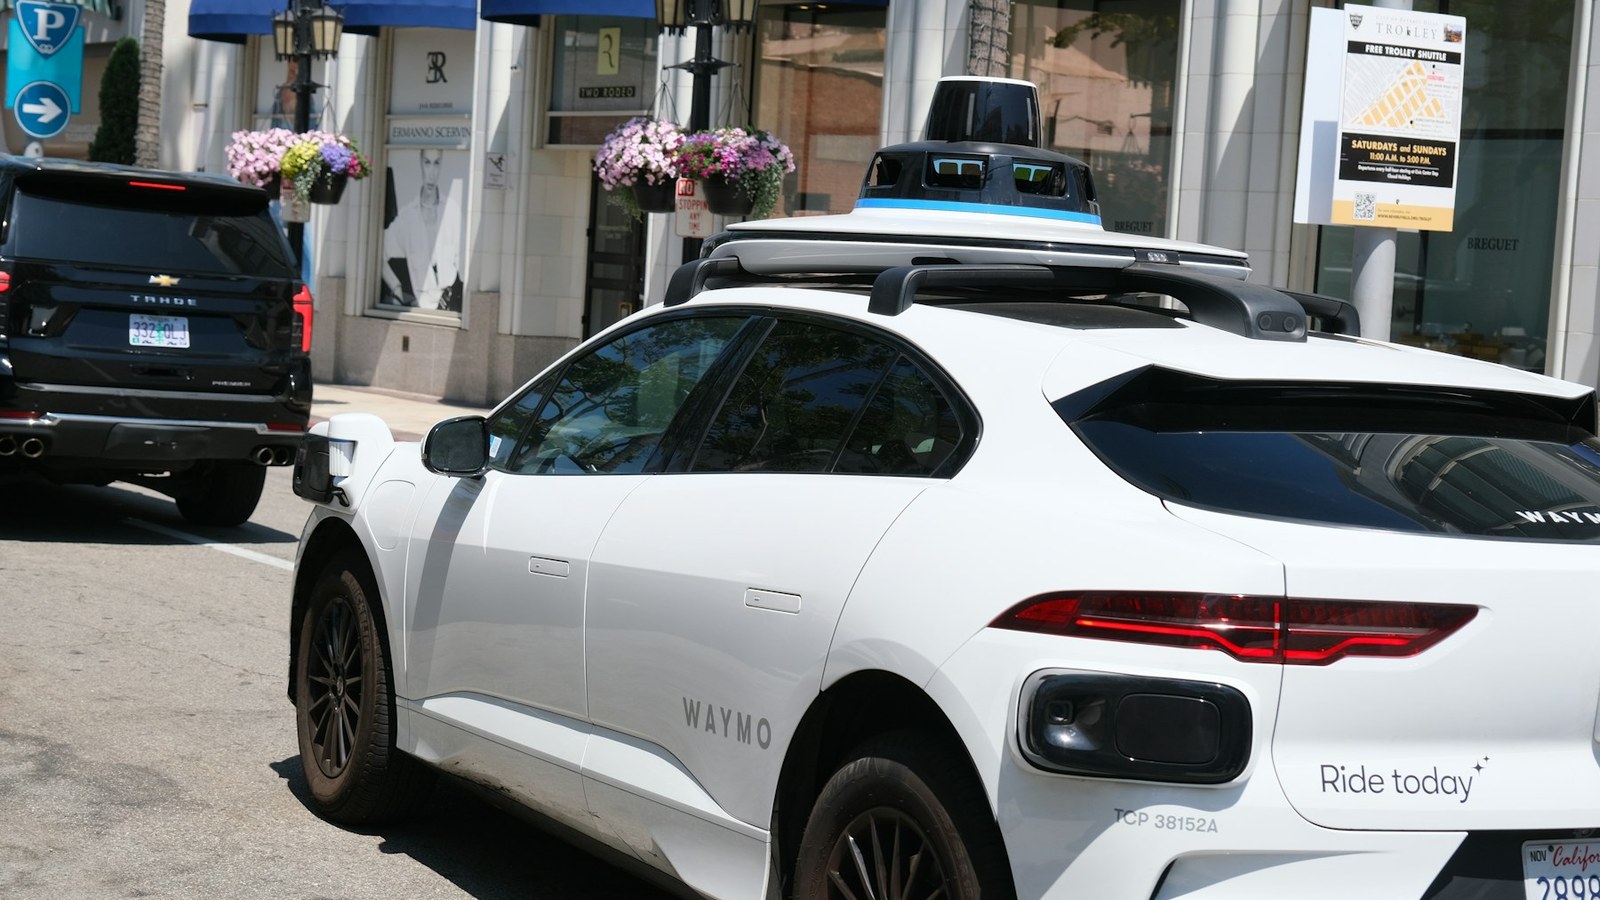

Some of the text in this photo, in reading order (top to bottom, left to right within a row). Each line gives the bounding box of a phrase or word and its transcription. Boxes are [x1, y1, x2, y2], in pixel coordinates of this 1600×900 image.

[33, 8, 65, 40] P
[1365, 44, 1447, 61] FREE TROLLEY SHUTTLE
[581, 87, 634, 98] TWO RODEO
[392, 126, 471, 138] ERMANNO SCERVIN
[1351, 140, 1447, 156] SATURDAYS and SUNDAYS
[1369, 152, 1384, 161] 11:00
[1407, 155, 1419, 163] 5:00
[679, 180, 694, 195] NO
[679, 199, 708, 210] STOPPIN
[1114, 220, 1154, 232] BREGUET
[1467, 237, 1519, 251] BREGUET
[130, 295, 197, 306] TAHOE
[133, 321, 156, 339] 332
[682, 697, 772, 750] WAYMO
[1320, 764, 1473, 803] Ride today
[1113, 808, 1218, 833] TCP 38152A
[1530, 850, 1547, 862] NOV
